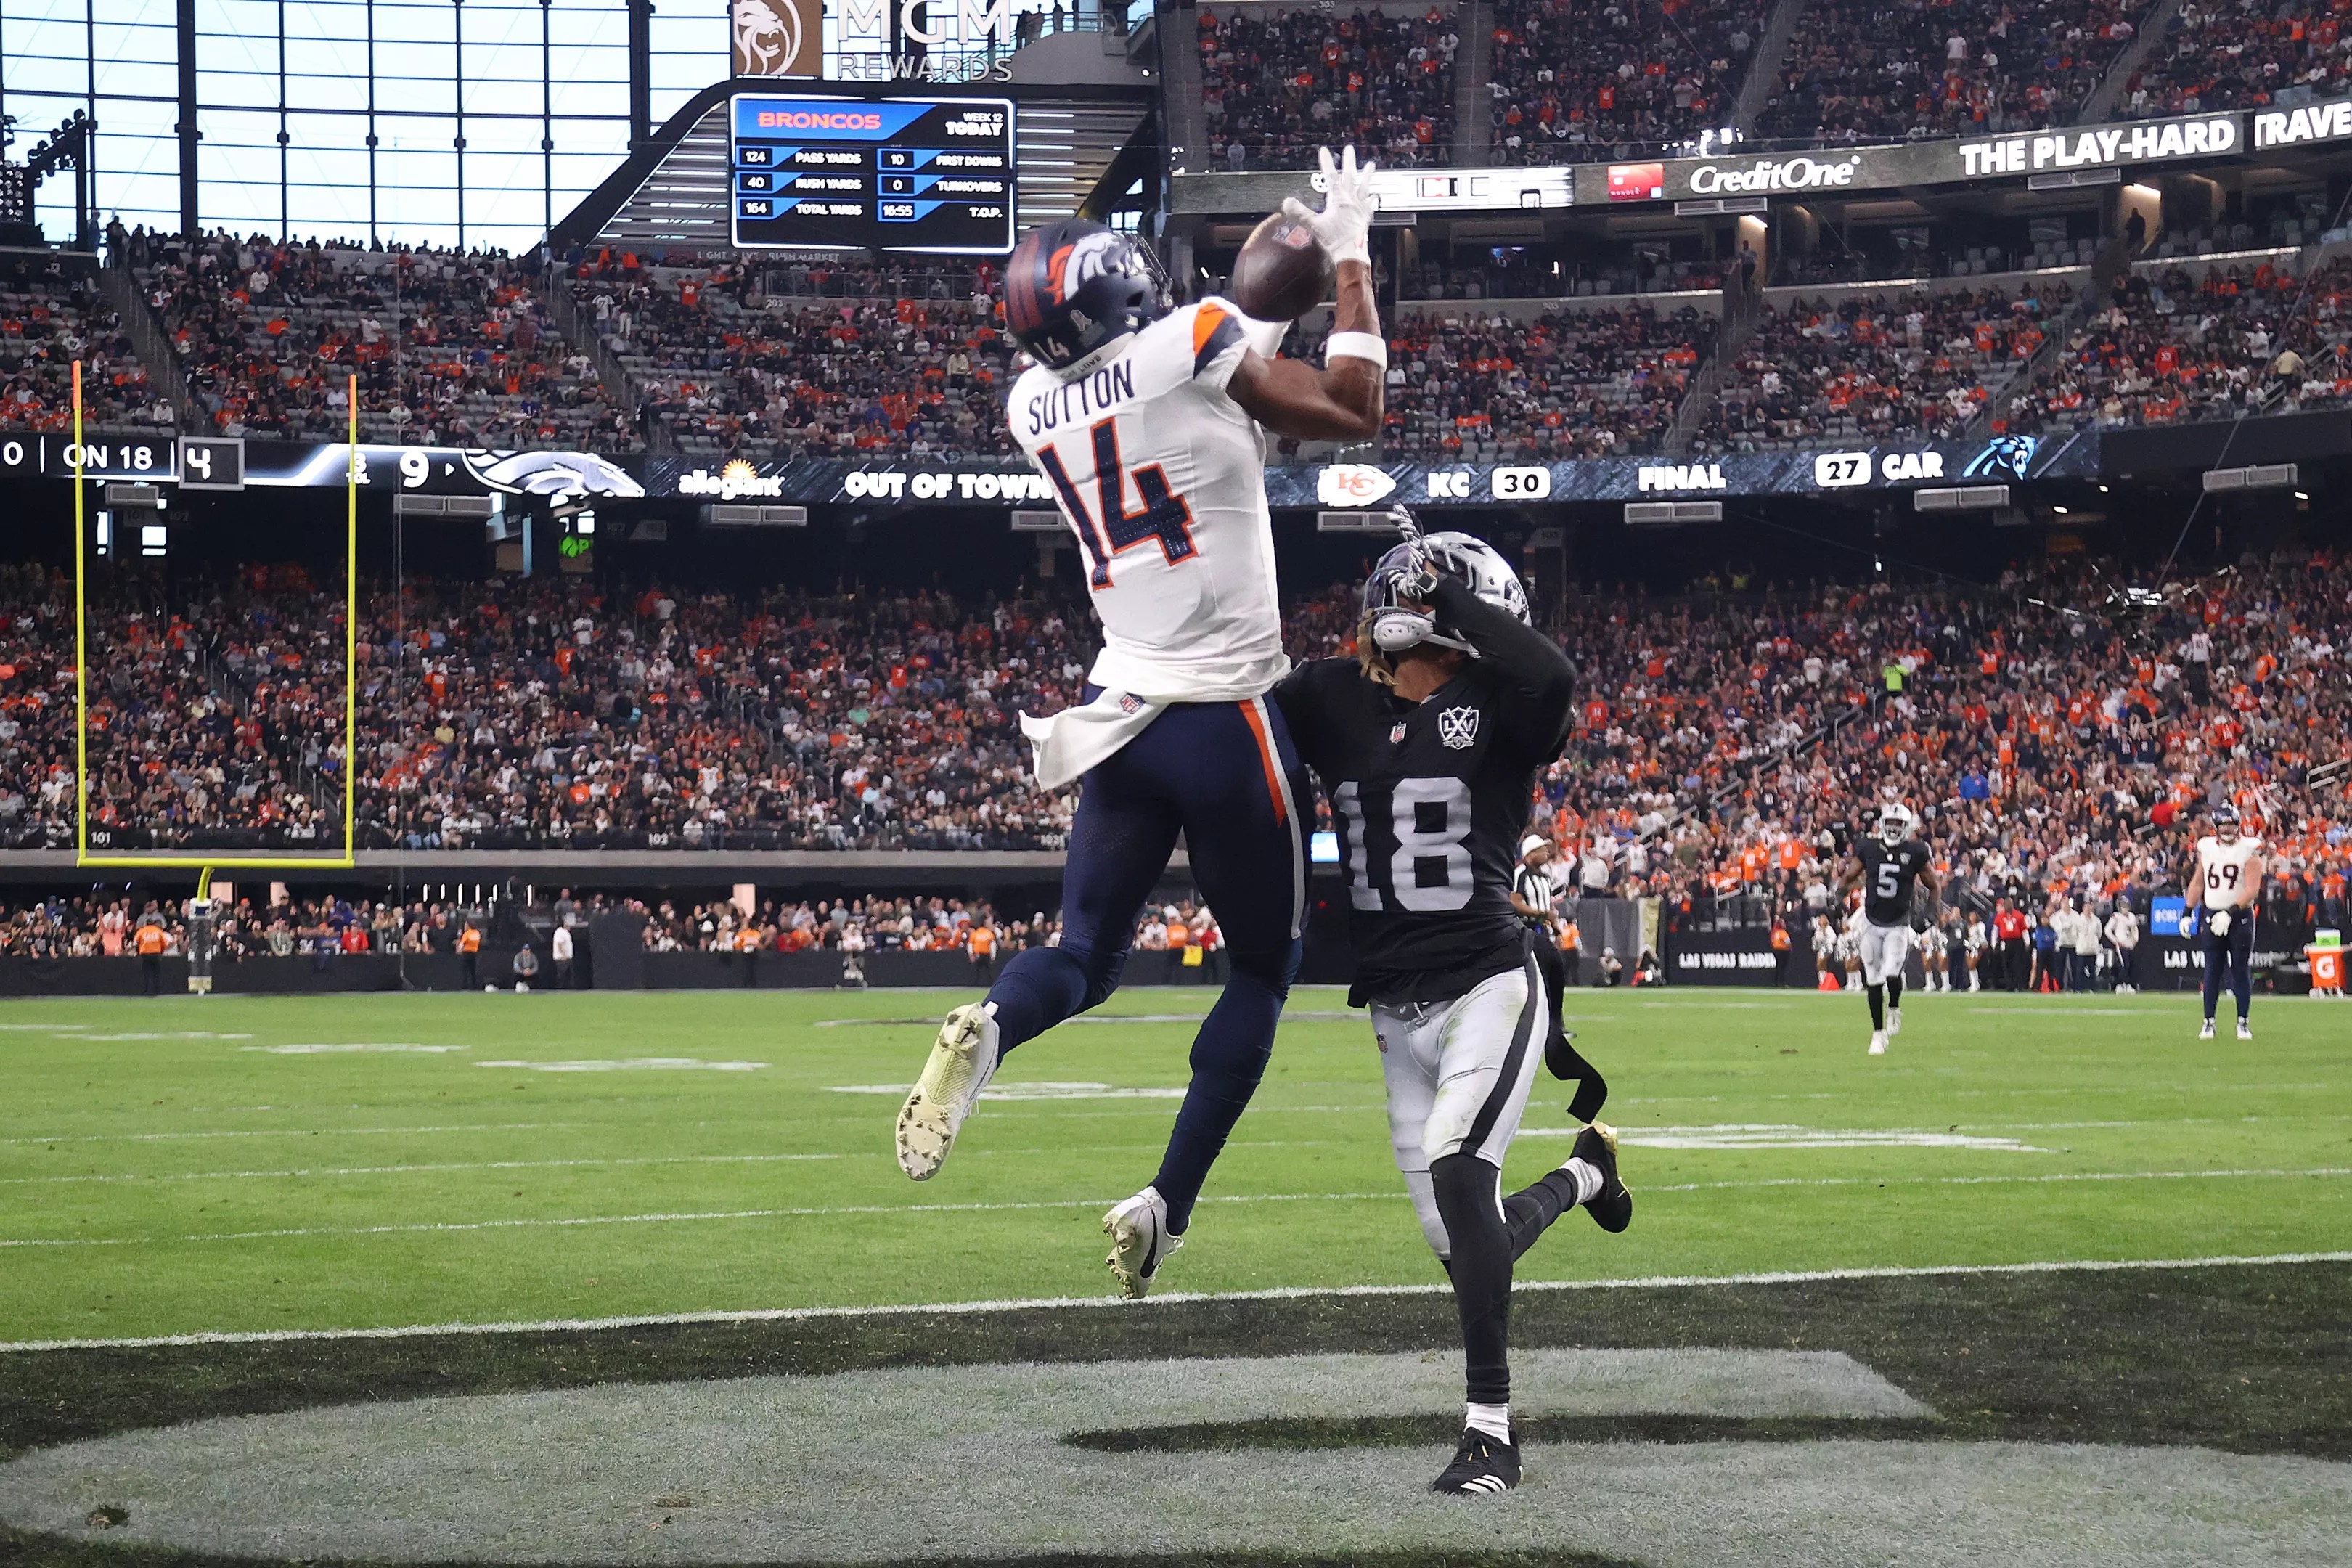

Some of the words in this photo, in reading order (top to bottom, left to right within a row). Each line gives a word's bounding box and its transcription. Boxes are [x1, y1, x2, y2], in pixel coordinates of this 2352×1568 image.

[838, 0, 1010, 45] MGM
[838, 53, 1013, 82] REWARDS
[758, 112, 881, 130] BRONCOS
[945, 122, 1003, 136] TODAY
[963, 113, 991, 123] WEEK
[992, 113, 1003, 123] 12
[745, 151, 767, 163] 124
[795, 152, 825, 164] PASS
[826, 153, 862, 165] YARDS
[1961, 144, 2026, 176] THE
[2033, 120, 2236, 168] PLAY-HARD
[890, 155, 905, 166] 10
[936, 156, 964, 167] FIRST
[965, 156, 1003, 167] DOWNS
[747, 177, 766, 189] 40
[796, 178, 825, 189] RUSH
[826, 179, 862, 190] YARDS
[892, 180, 903, 191] 0
[936, 181, 1003, 192] TURNOVERS
[1690, 158, 1854, 194] CreditOne
[746, 203, 767, 214] 164
[795, 203, 828, 216] TOTAL
[828, 204, 862, 216] YARDS
[883, 205, 914, 217] 16:55
[969, 207, 1003, 219] T.O.P.
[1033, 336, 1071, 363] 14
[1029, 357, 1135, 436] SUTTON
[62, 444, 107, 469] ON
[120, 446, 152, 470] 18
[187, 447, 211, 480] 4
[1826, 460, 1860, 480] 27
[1882, 452, 1944, 479] CAR
[399, 451, 430, 488] 9
[1638, 465, 1726, 491] FINAL
[679, 469, 783, 501] allegiant
[844, 471, 907, 498] OUT
[911, 473, 953, 499] OF
[957, 473, 1053, 499] TOWN
[1428, 472, 1470, 497] KC
[1503, 473, 1540, 493] 30
[1036, 417, 1199, 591] 14
[1444, 719, 1475, 732] LXV
[91, 831, 111, 844] 101
[648, 833, 669, 846] 102
[1334, 777, 1474, 912] 18
[1877, 863, 1900, 899] 5
[2207, 863, 2239, 890] 69
[1678, 945, 1700, 969] LAS
[1701, 945, 1736, 969] VEGAS
[2164, 950, 2188, 968] LAS
[2316, 955, 2335, 979] G
